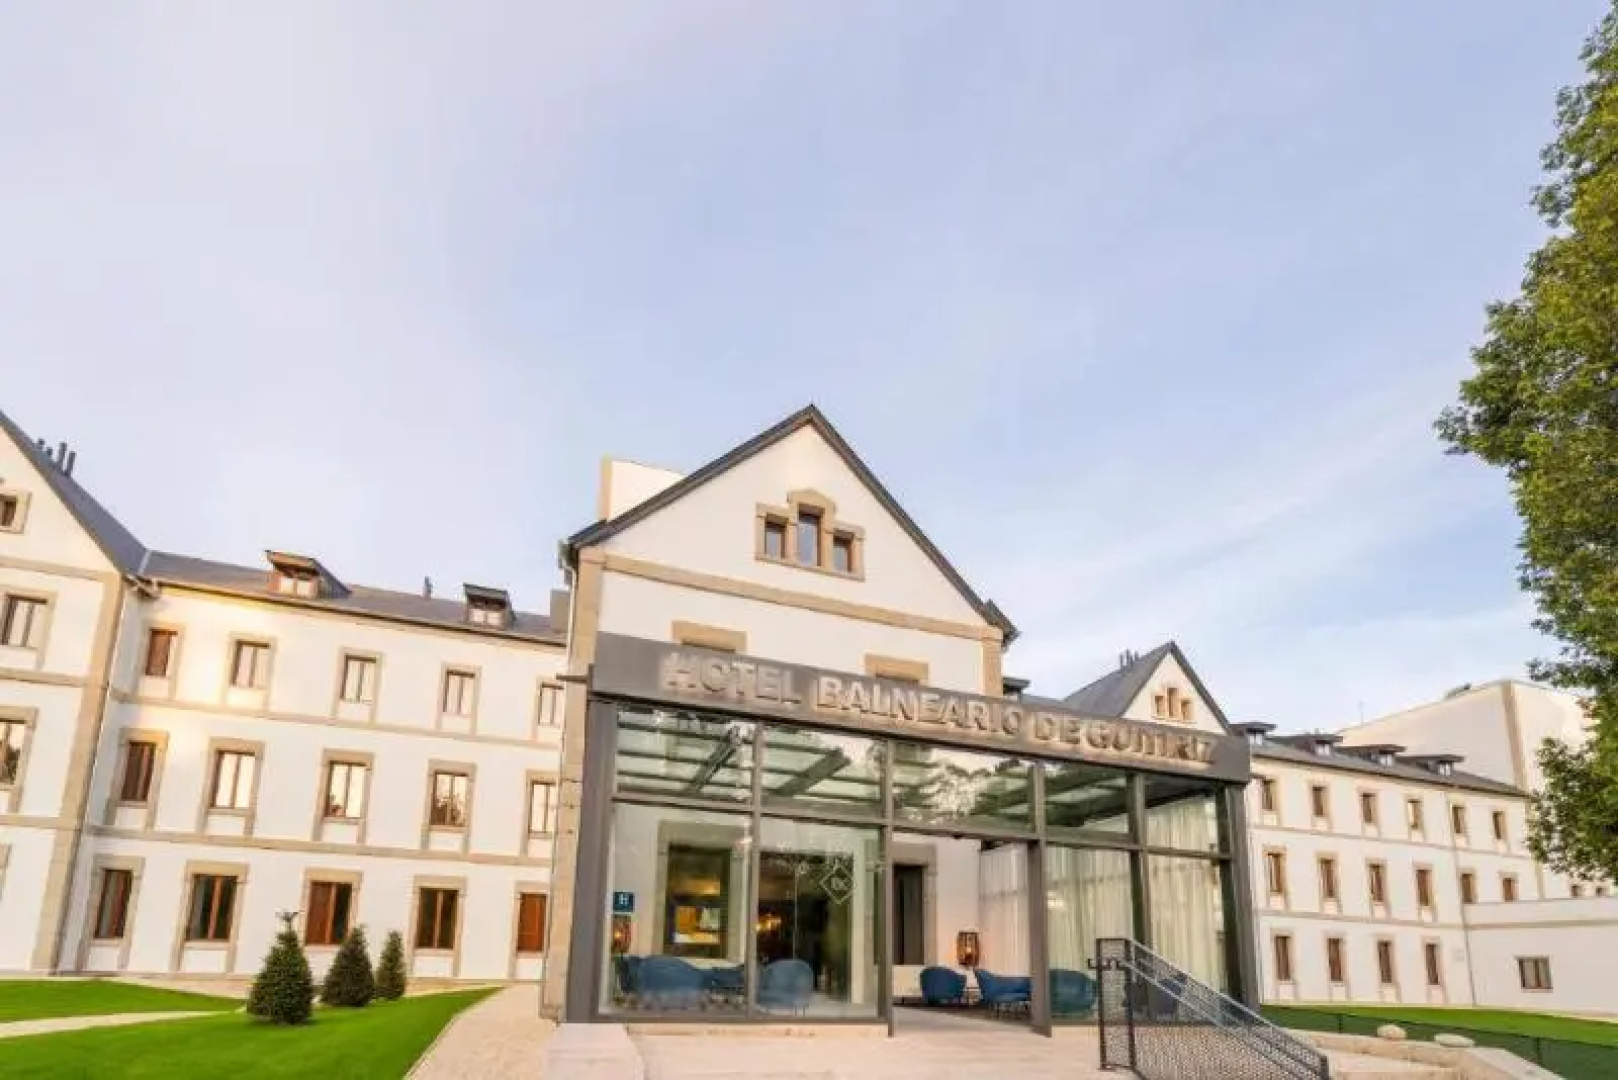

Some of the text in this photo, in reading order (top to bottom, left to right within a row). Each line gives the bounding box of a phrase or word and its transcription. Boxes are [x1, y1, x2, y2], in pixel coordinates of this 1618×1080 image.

[663, 652, 801, 704] HOTEL
[811, 676, 1024, 735] BALNEARIO
[1033, 711, 1082, 746] DE
